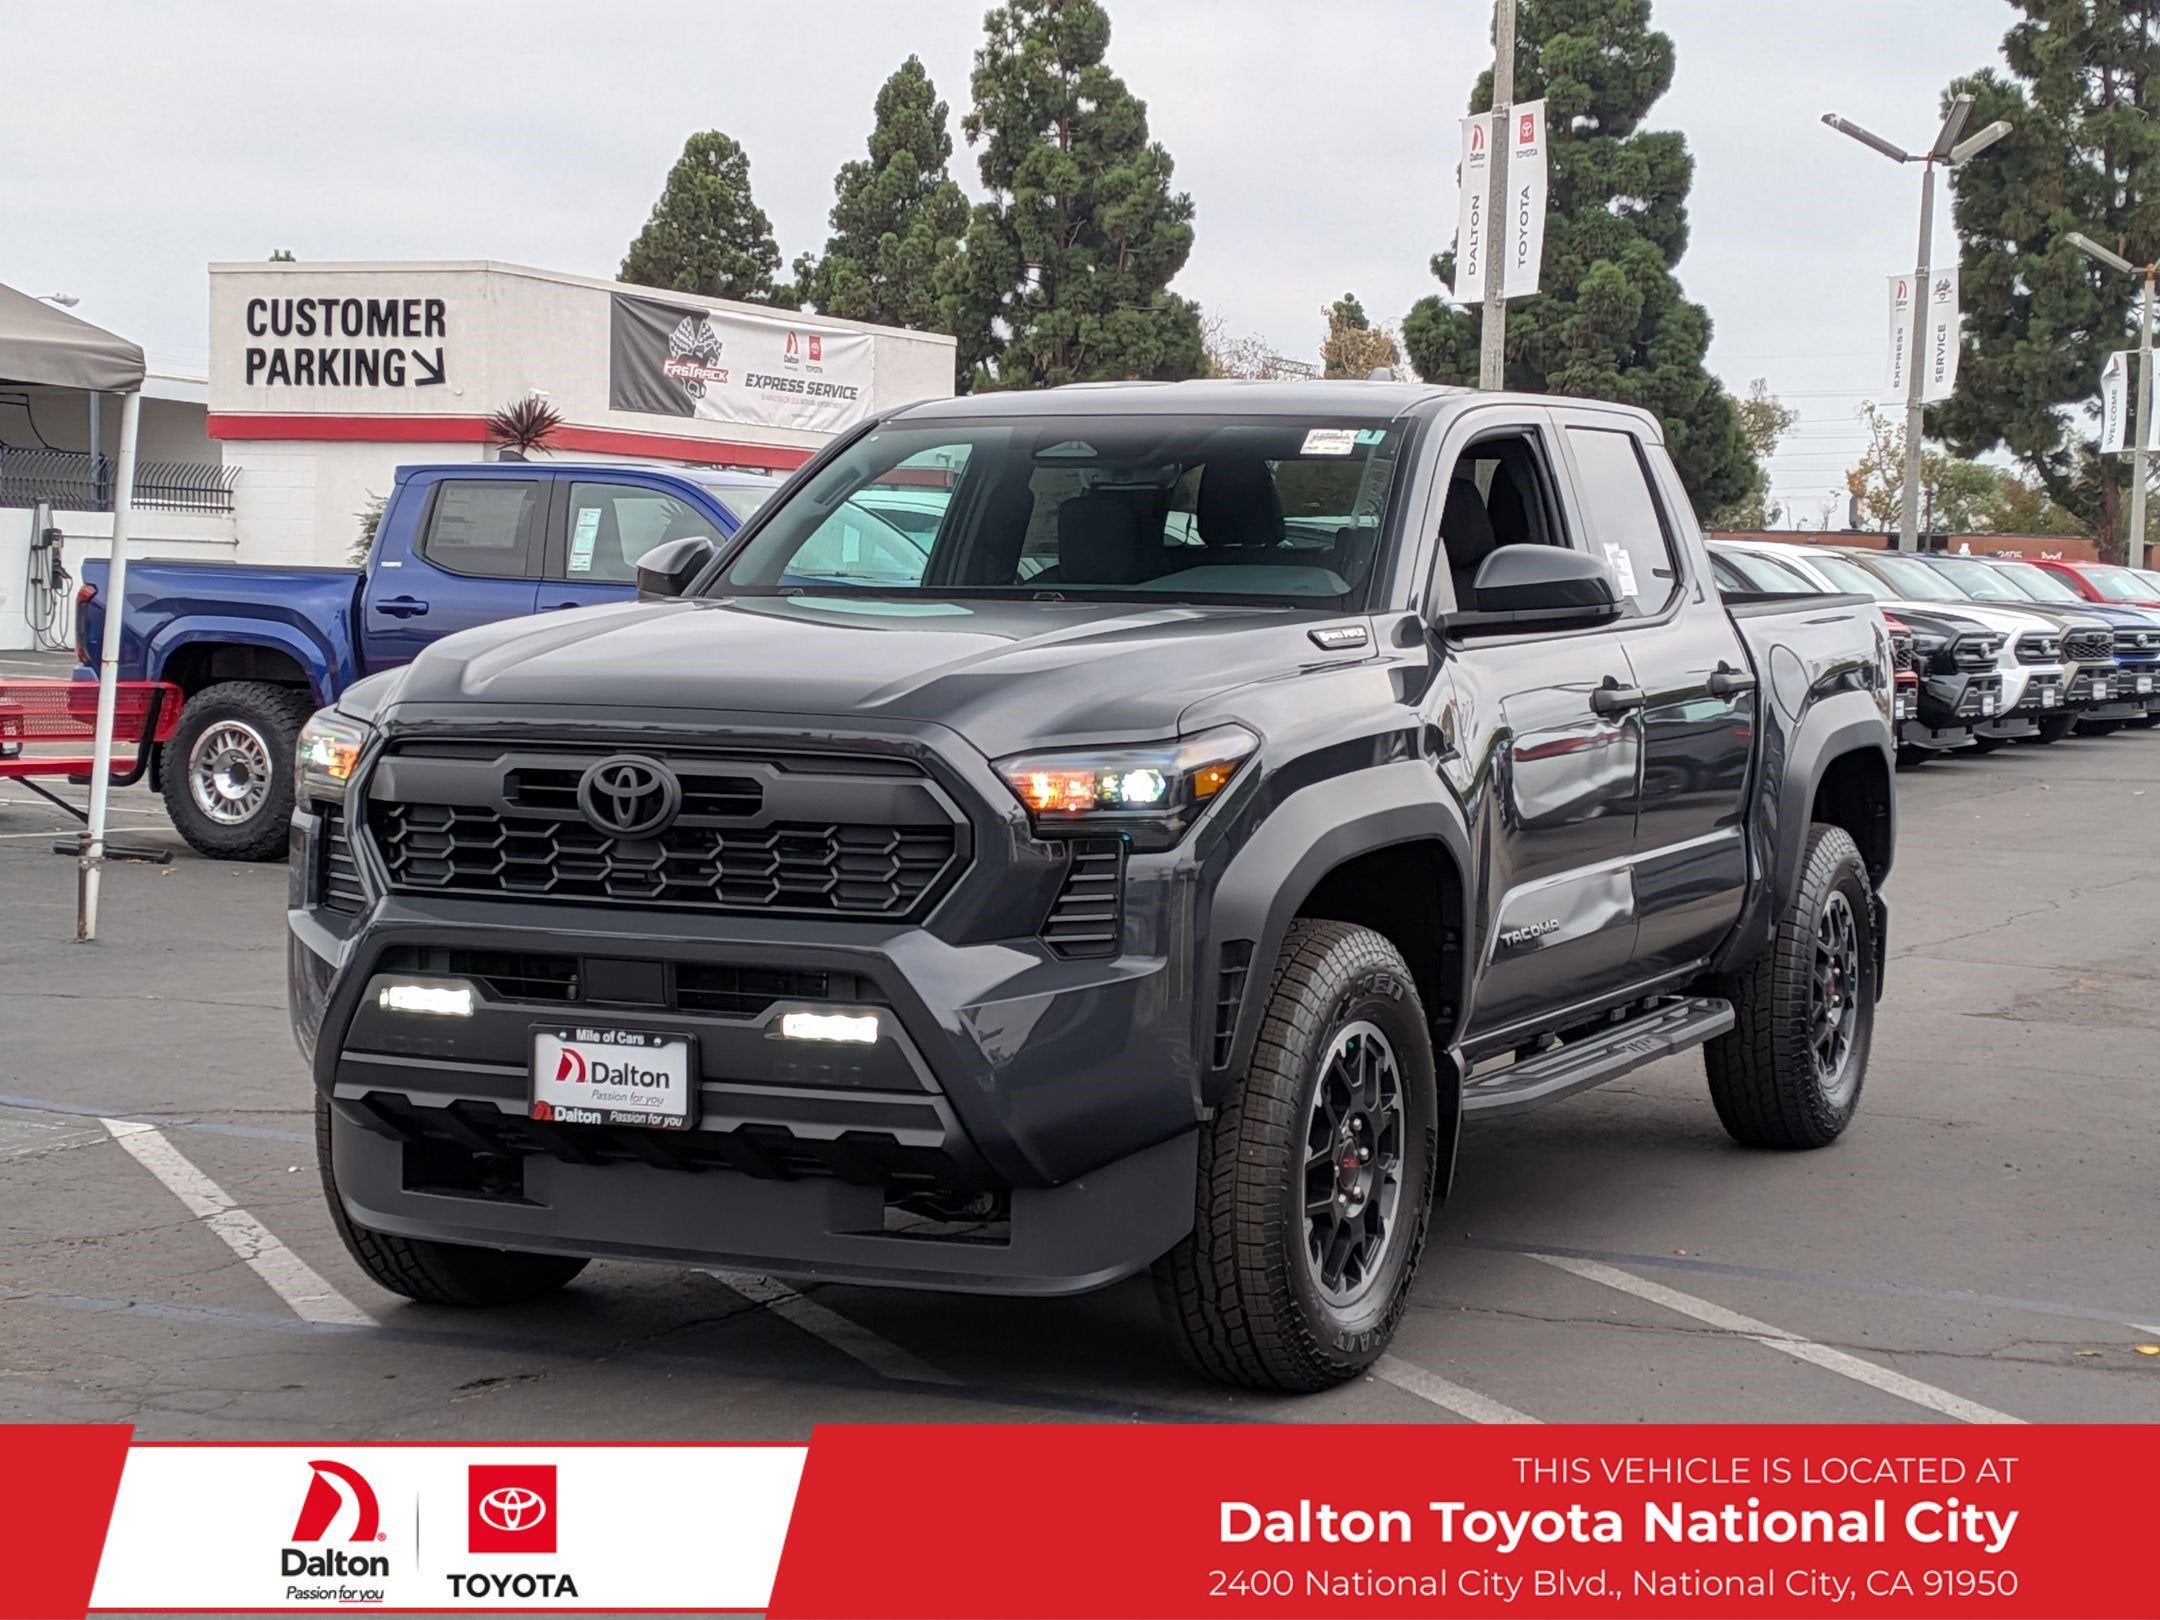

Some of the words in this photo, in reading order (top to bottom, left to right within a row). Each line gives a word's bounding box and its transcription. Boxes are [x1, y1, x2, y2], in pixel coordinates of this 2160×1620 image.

[1468, 195, 1480, 275] DALTON
[1517, 185, 1530, 269] TOYOTA
[247, 298, 445, 337] CUSTOMER
[246, 348, 405, 387] PARKING
[1893, 327, 1904, 388] EXPRESS
[1935, 324, 1947, 384] SERVICE
[745, 373, 805, 395] EXPRESS
[806, 378, 858, 400] SERVICE
[2107, 388, 2118, 445] WELCOME
[1500, 919, 1559, 946] TACOMA
[576, 1029, 600, 1042] Mile
[602, 1030, 615, 1043] of
[616, 1031, 645, 1045] Cars
[591, 1061, 670, 1089] Dalton
[554, 1106, 602, 1124] Dalton
[609, 1111, 647, 1124] Passion
[647, 1113, 663, 1126] for
[662, 1115, 684, 1128] you
[591, 1089, 628, 1102] Passion
[630, 1091, 645, 1105] for
[645, 1096, 665, 1106] you
